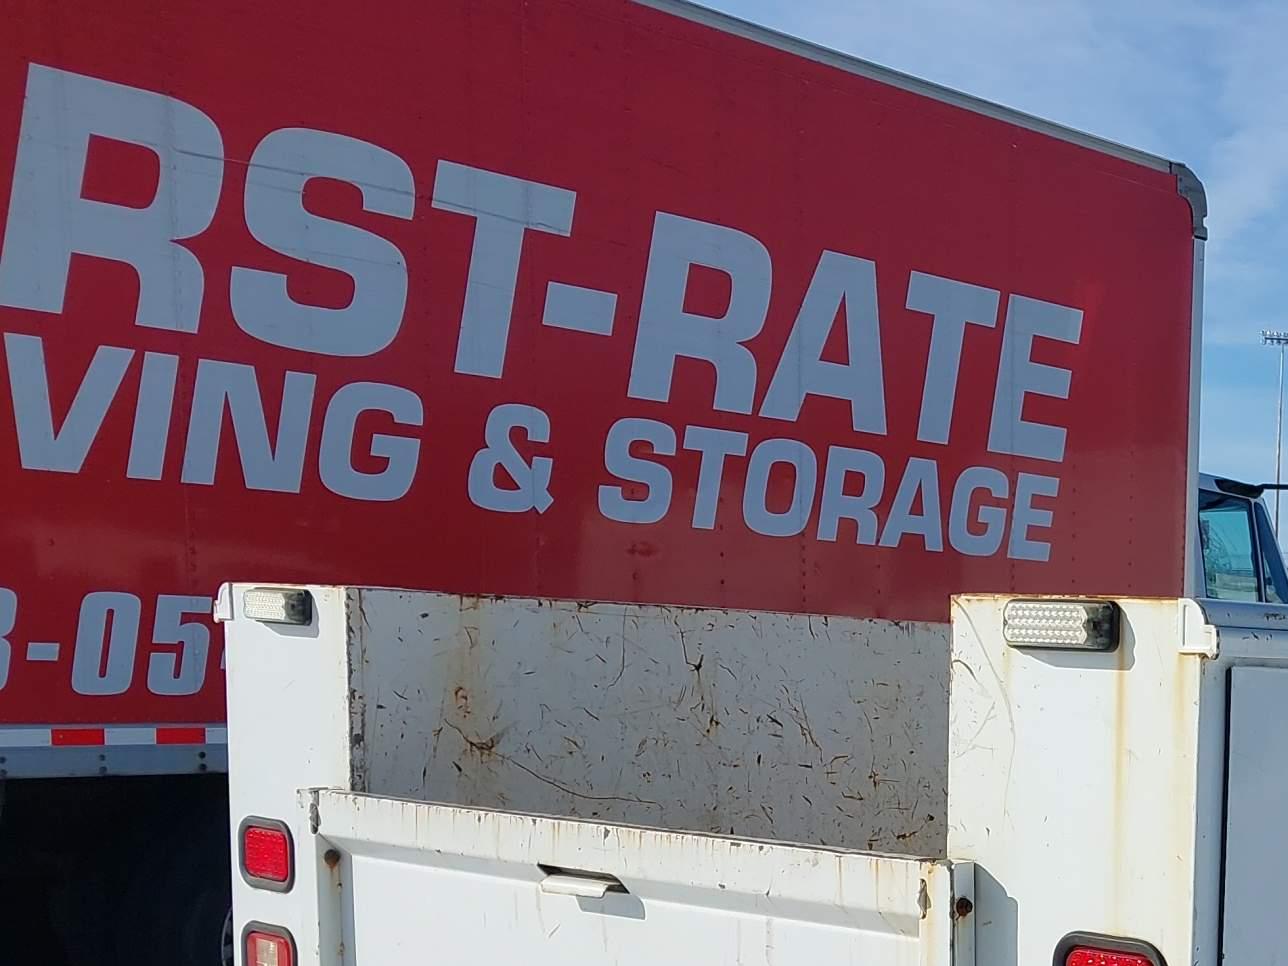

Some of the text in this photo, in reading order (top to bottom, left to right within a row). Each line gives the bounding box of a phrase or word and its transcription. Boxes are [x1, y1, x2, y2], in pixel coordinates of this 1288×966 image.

[0, 62, 1084, 463] RST-RATE
[4, 333, 1060, 562] VING & STORAGE
